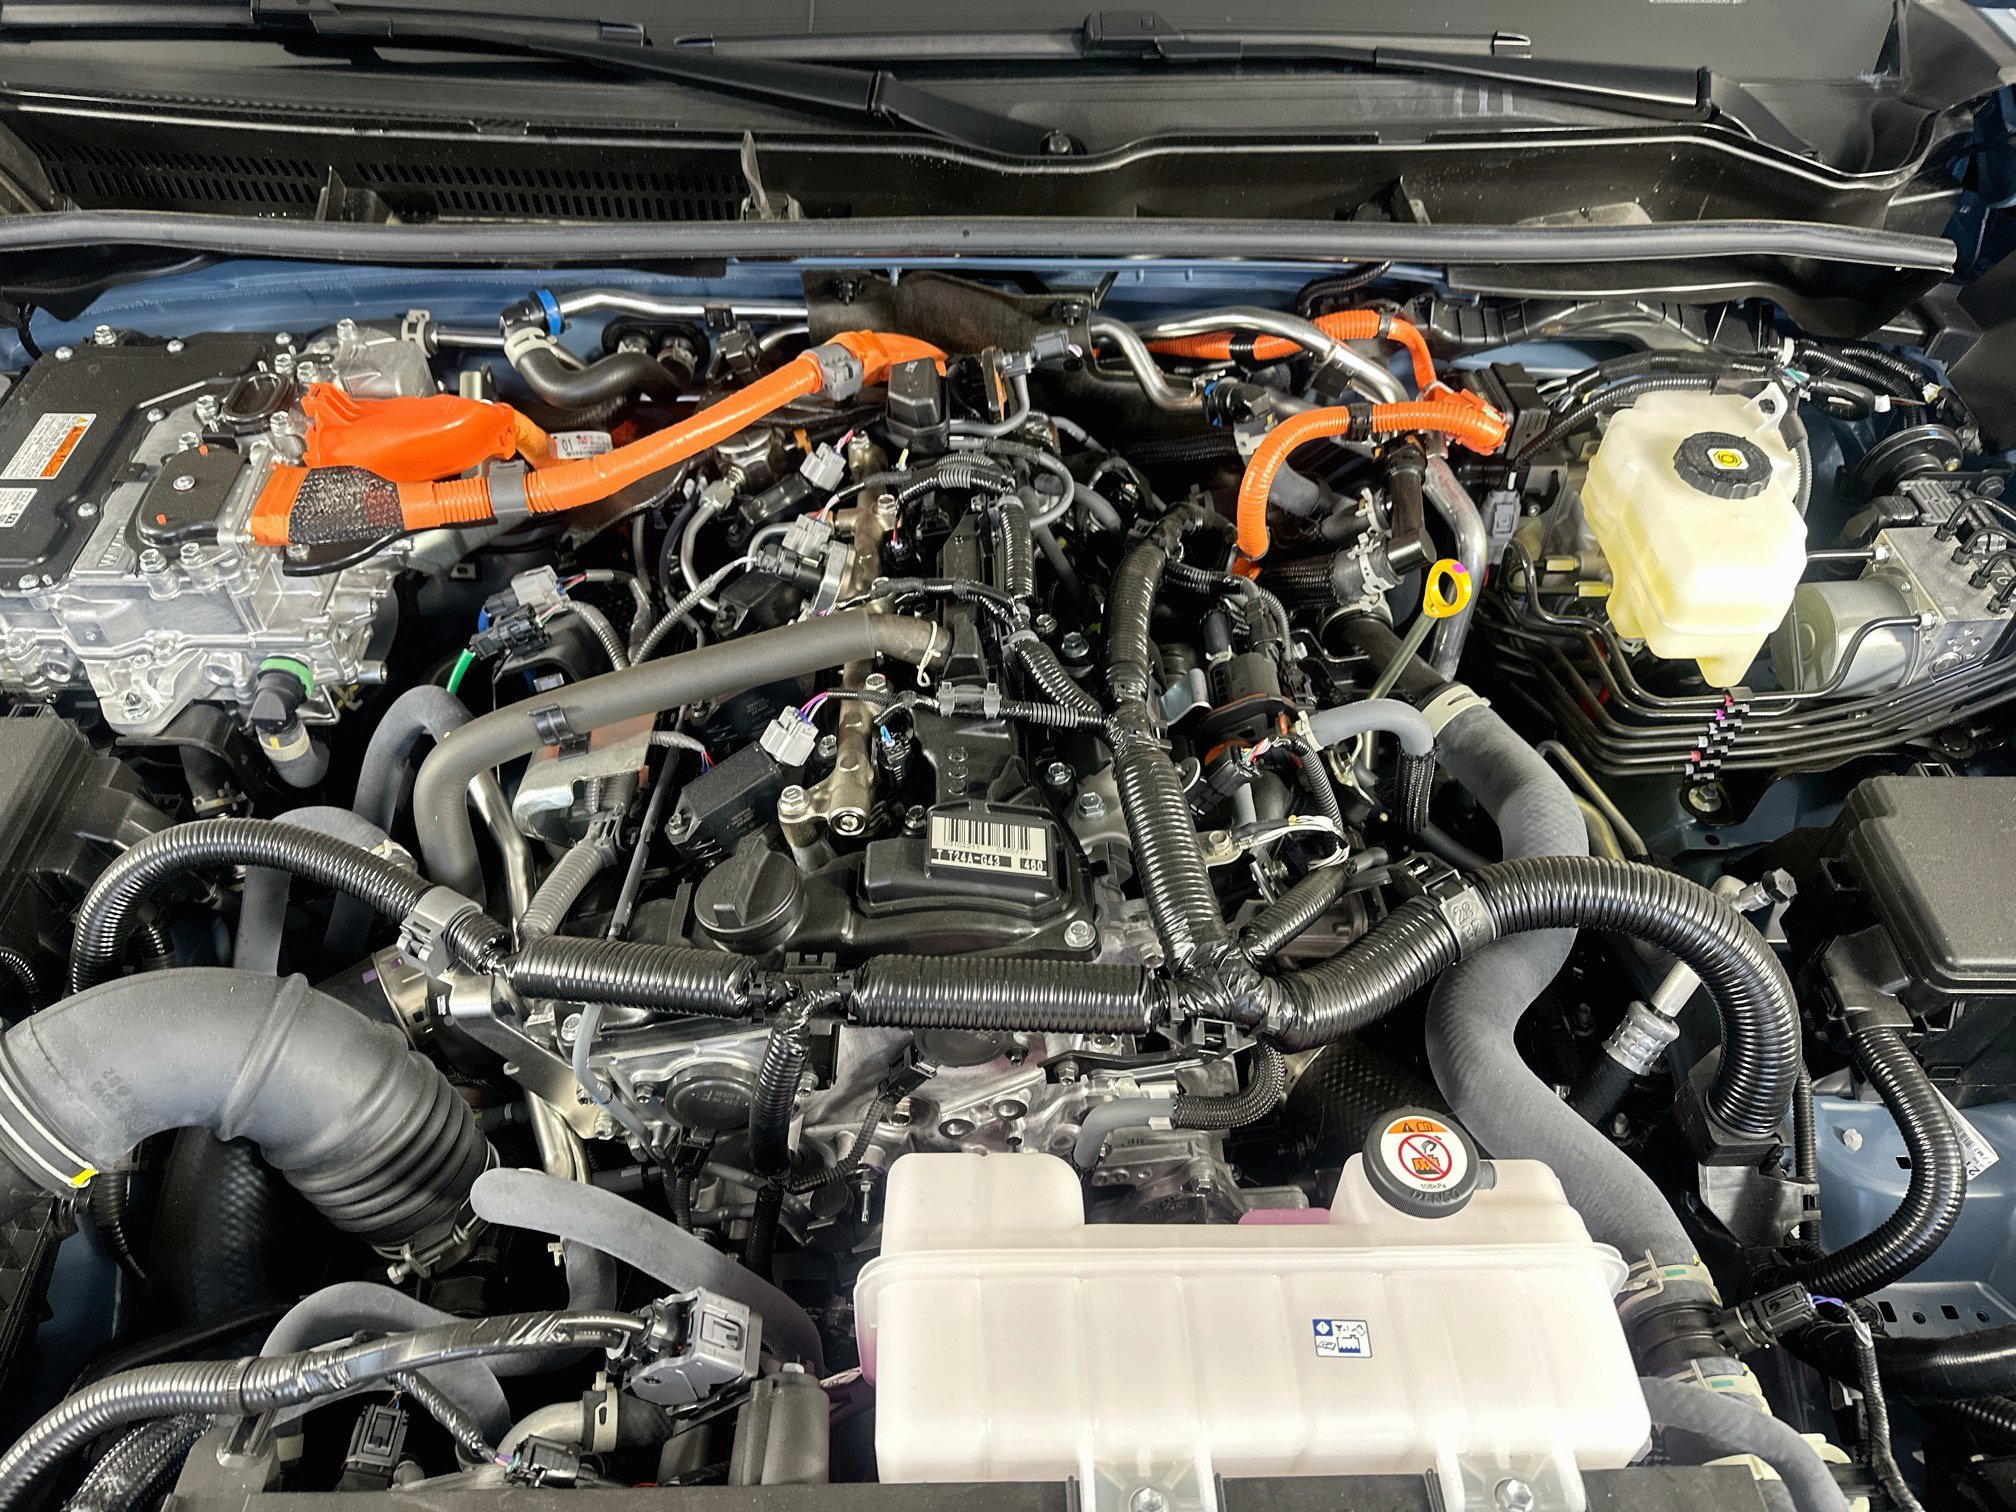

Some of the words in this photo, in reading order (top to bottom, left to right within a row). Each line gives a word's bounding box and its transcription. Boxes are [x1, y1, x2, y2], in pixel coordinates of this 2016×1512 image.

[937, 849, 943, 860] T
[948, 850, 1001, 867] T24A-G43
[1024, 859, 1044, 871] 460
